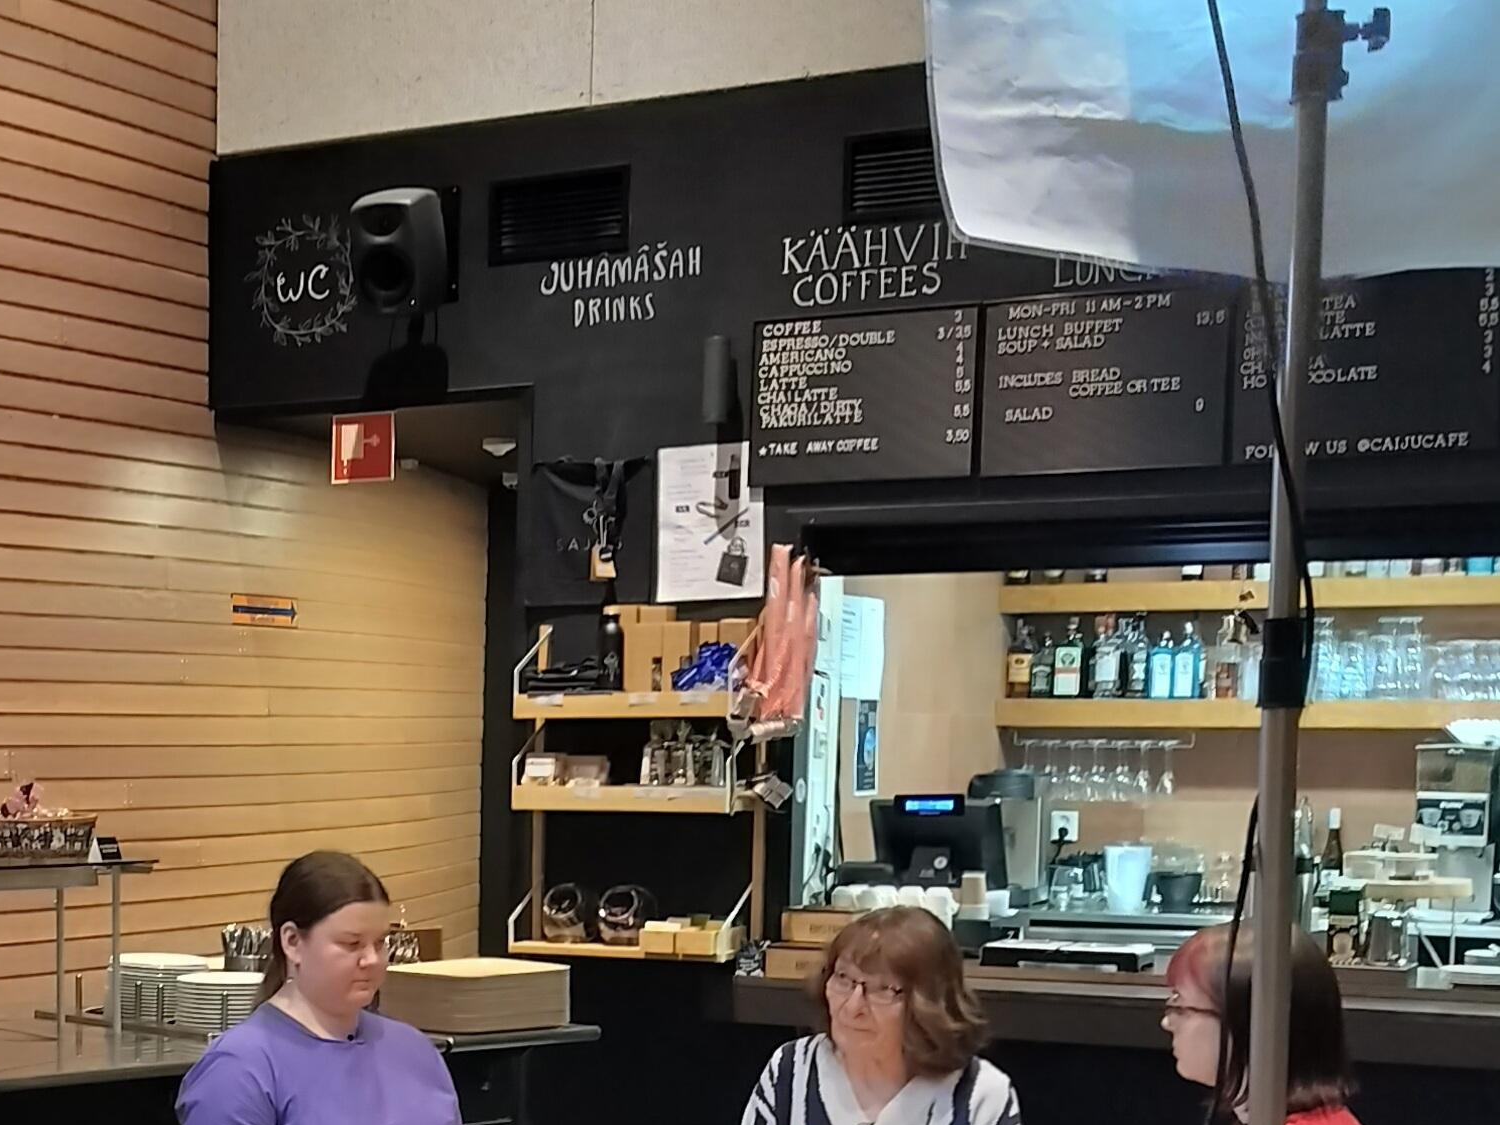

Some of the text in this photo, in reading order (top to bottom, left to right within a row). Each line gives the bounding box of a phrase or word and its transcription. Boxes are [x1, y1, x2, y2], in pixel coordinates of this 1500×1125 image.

[276, 263, 330, 303] WC
[792, 261, 941, 307] COFFEES
[573, 292, 654, 328] DRINKS
[762, 320, 822, 338] COFFEE
[998, 318, 1123, 341] LUNCH BUFFET
[762, 330, 896, 352] ESPRESSO/DOUBLE
[997, 338, 1037, 355] SOUP
[1056, 334, 1105, 351] SALAD
[758, 347, 847, 366] AMERICANO
[757, 360, 853, 379] CAPPUCCINO
[1071, 367, 1121, 384] BREAD
[759, 376, 808, 392] LATTE
[1069, 380, 1123, 398] COFFEE
[1005, 406, 1053, 423] SALAD
[806, 440, 835, 454] AWAY
[836, 437, 879, 453] COFFEE
[1326, 440, 1348, 454] US
